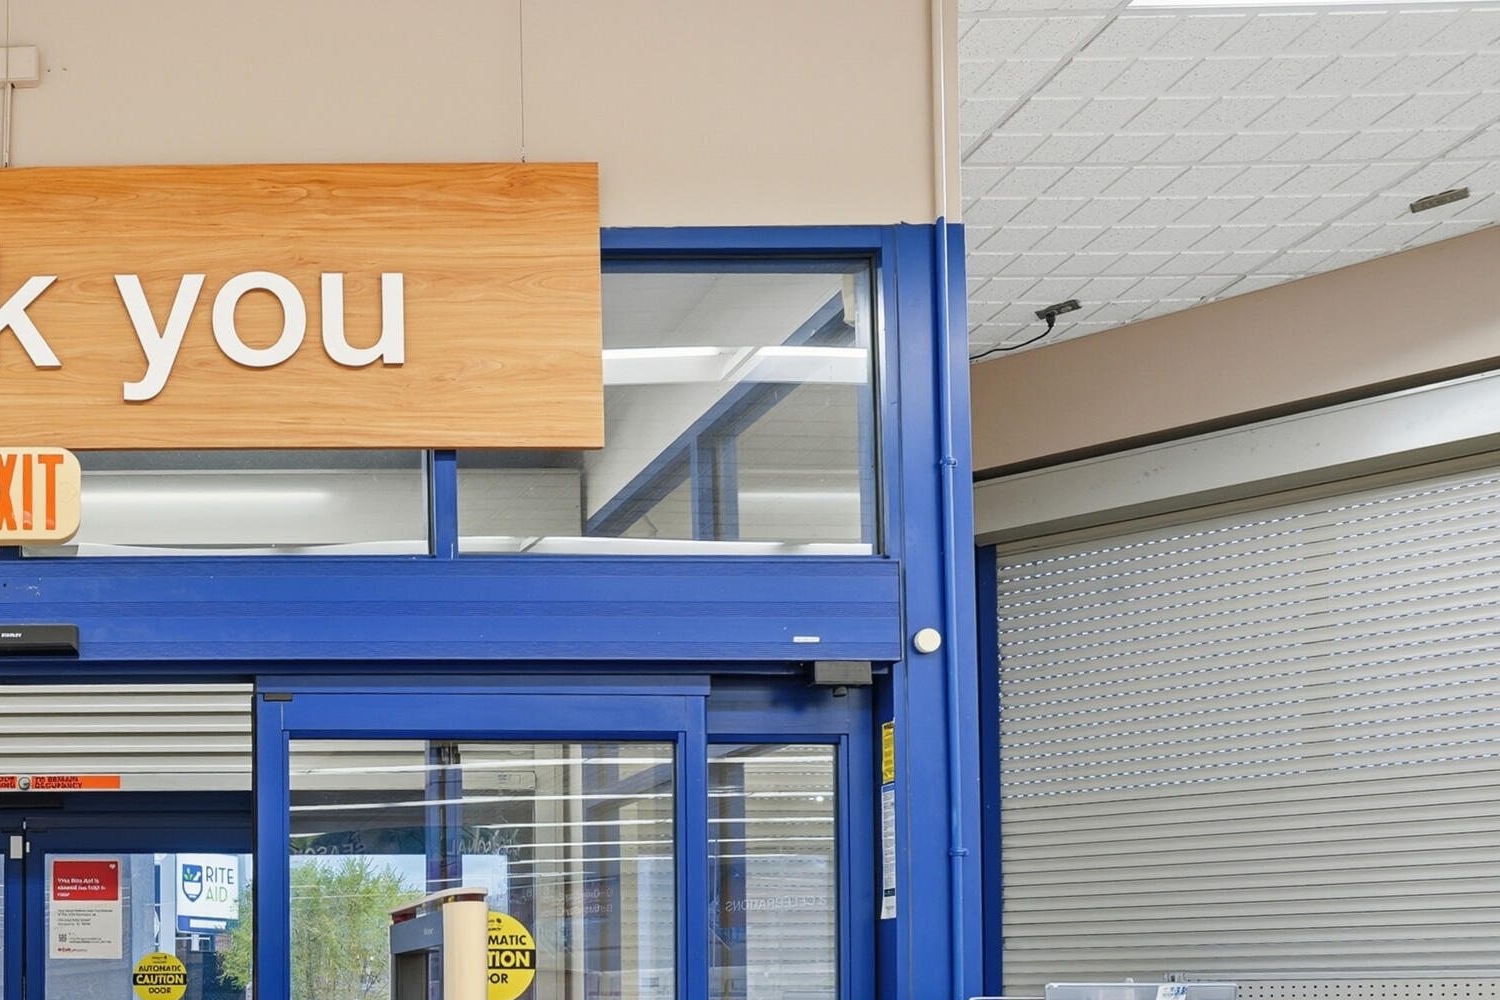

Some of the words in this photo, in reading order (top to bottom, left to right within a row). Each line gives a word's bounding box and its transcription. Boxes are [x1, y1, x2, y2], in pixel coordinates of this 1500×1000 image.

[115, 270, 405, 402] you
[206, 866, 234, 884] RITE
[205, 887, 228, 902] AID
[488, 935, 527, 946] MATIC
[488, 950, 531, 968] TION
[136, 974, 184, 984] CAUTION
[488, 973, 508, 984] OR
